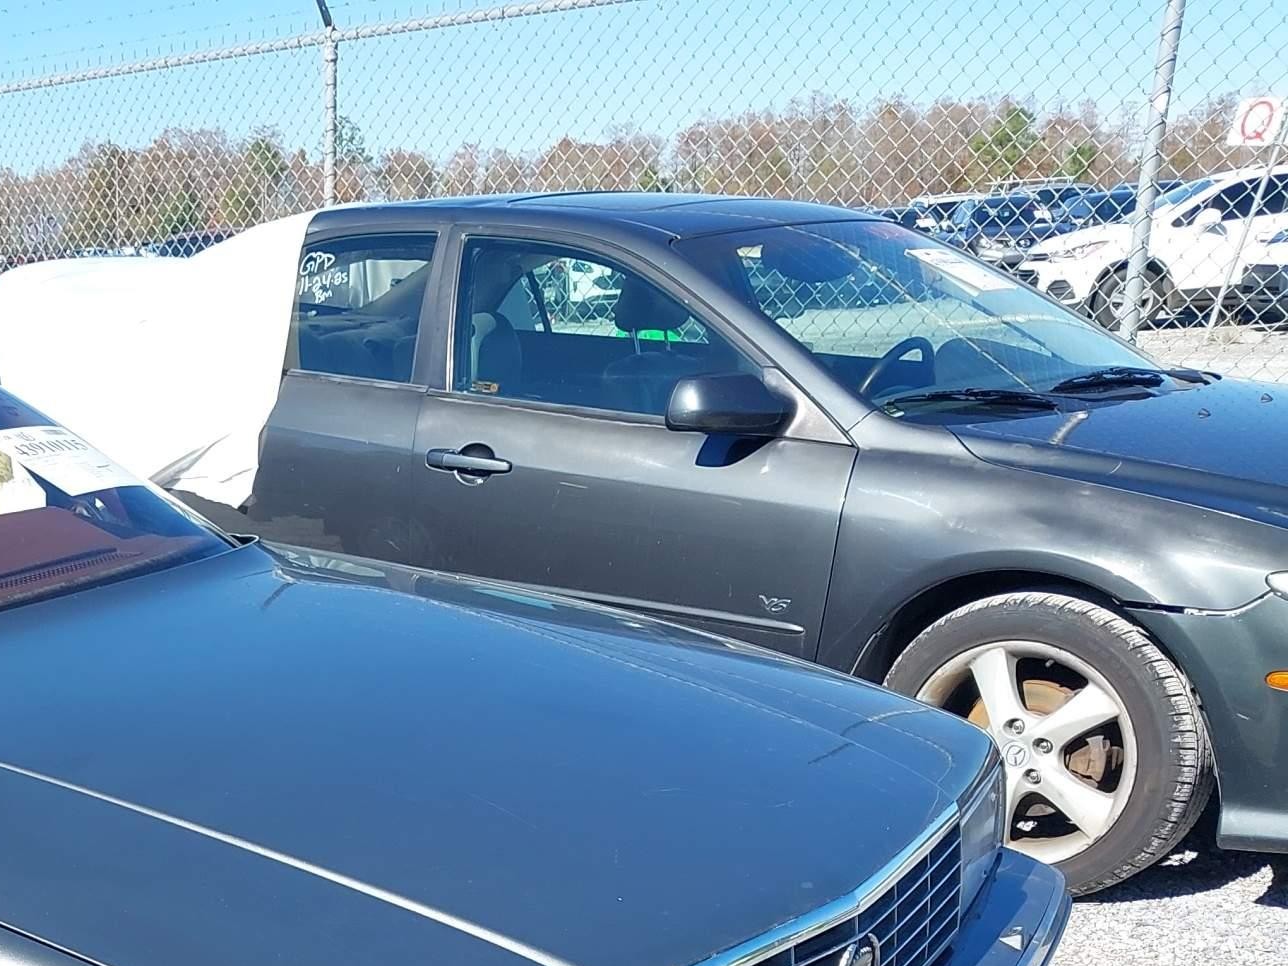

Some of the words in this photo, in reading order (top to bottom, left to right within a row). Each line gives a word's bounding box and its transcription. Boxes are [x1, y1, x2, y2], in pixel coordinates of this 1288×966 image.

[1241, 101, 1274, 142] Q
[300, 251, 336, 275] GPD
[14, 439, 89, 457] 43910115
[758, 594, 792, 614] V6
